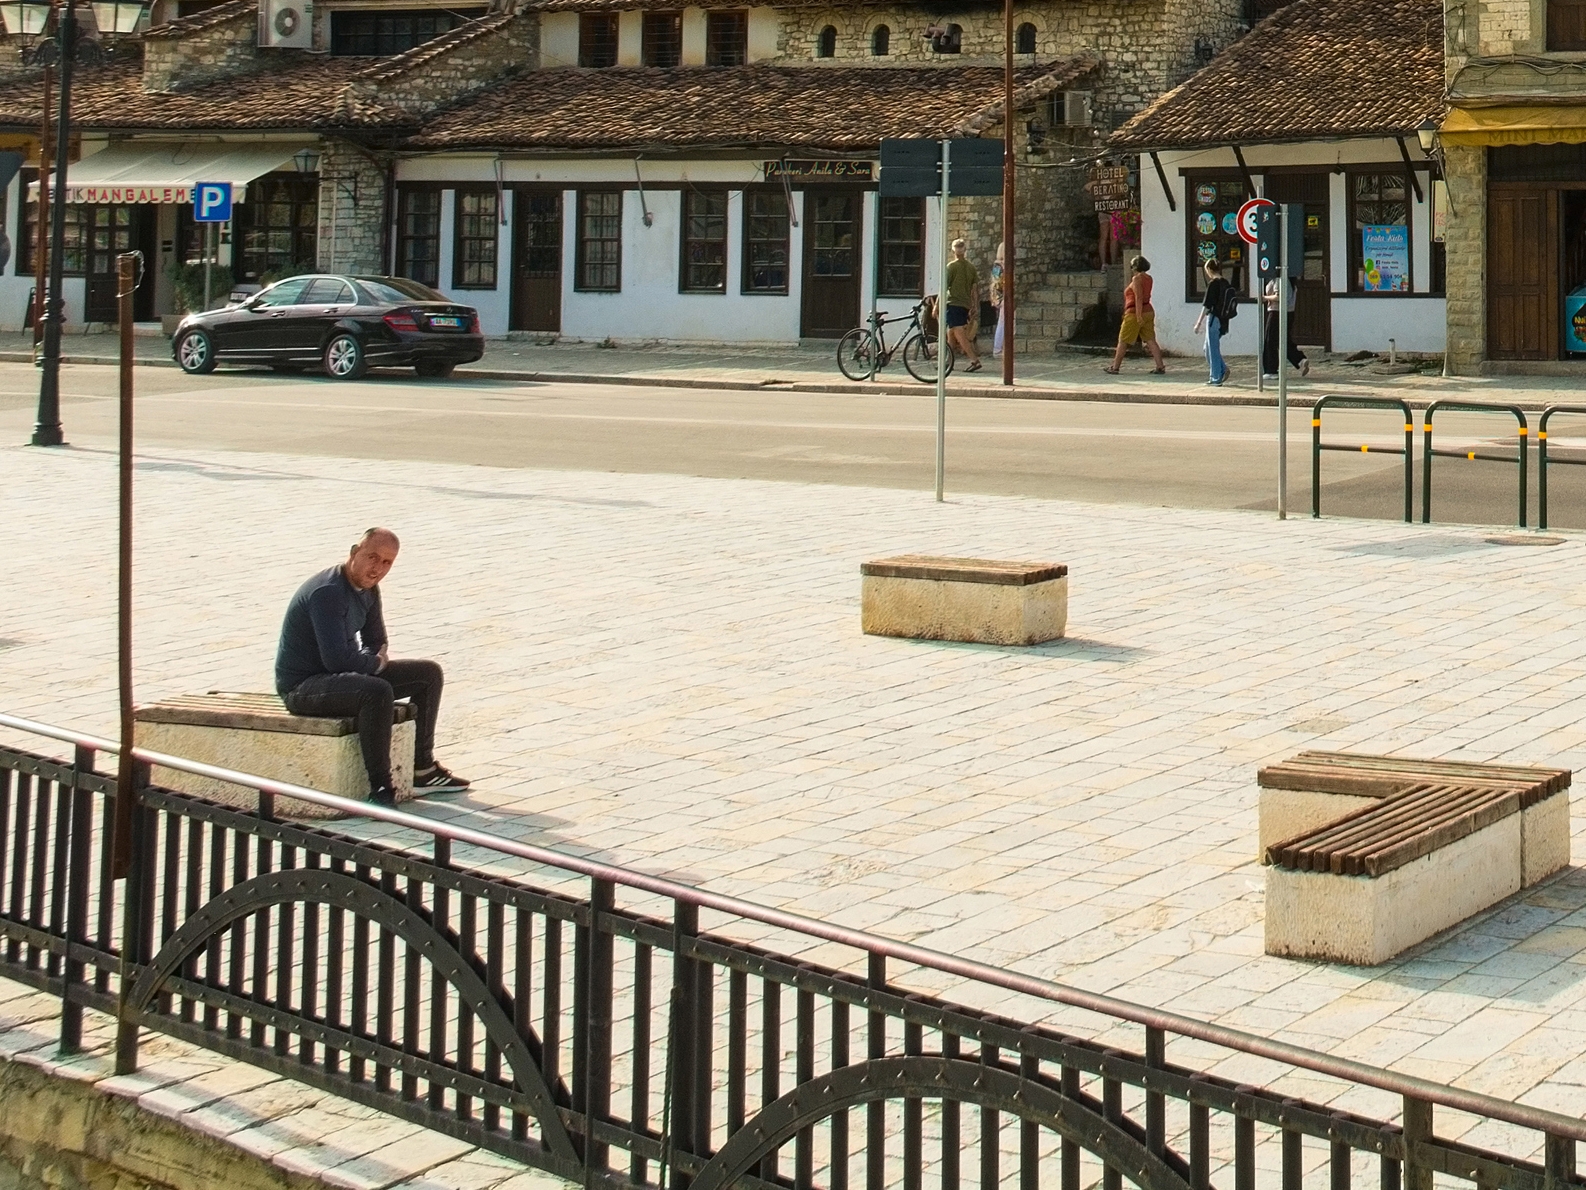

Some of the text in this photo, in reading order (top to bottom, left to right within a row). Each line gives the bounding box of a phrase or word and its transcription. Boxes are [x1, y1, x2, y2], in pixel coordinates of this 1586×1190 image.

[1488, 130, 1536, 142] MINI
[847, 161, 870, 175] Sara
[1097, 167, 1124, 179] HOTEL
[87, 188, 185, 202] MANGALEM
[1093, 183, 1129, 196] BERATINO
[201, 186, 225, 217] P
[1094, 199, 1129, 212] RESTORANT
